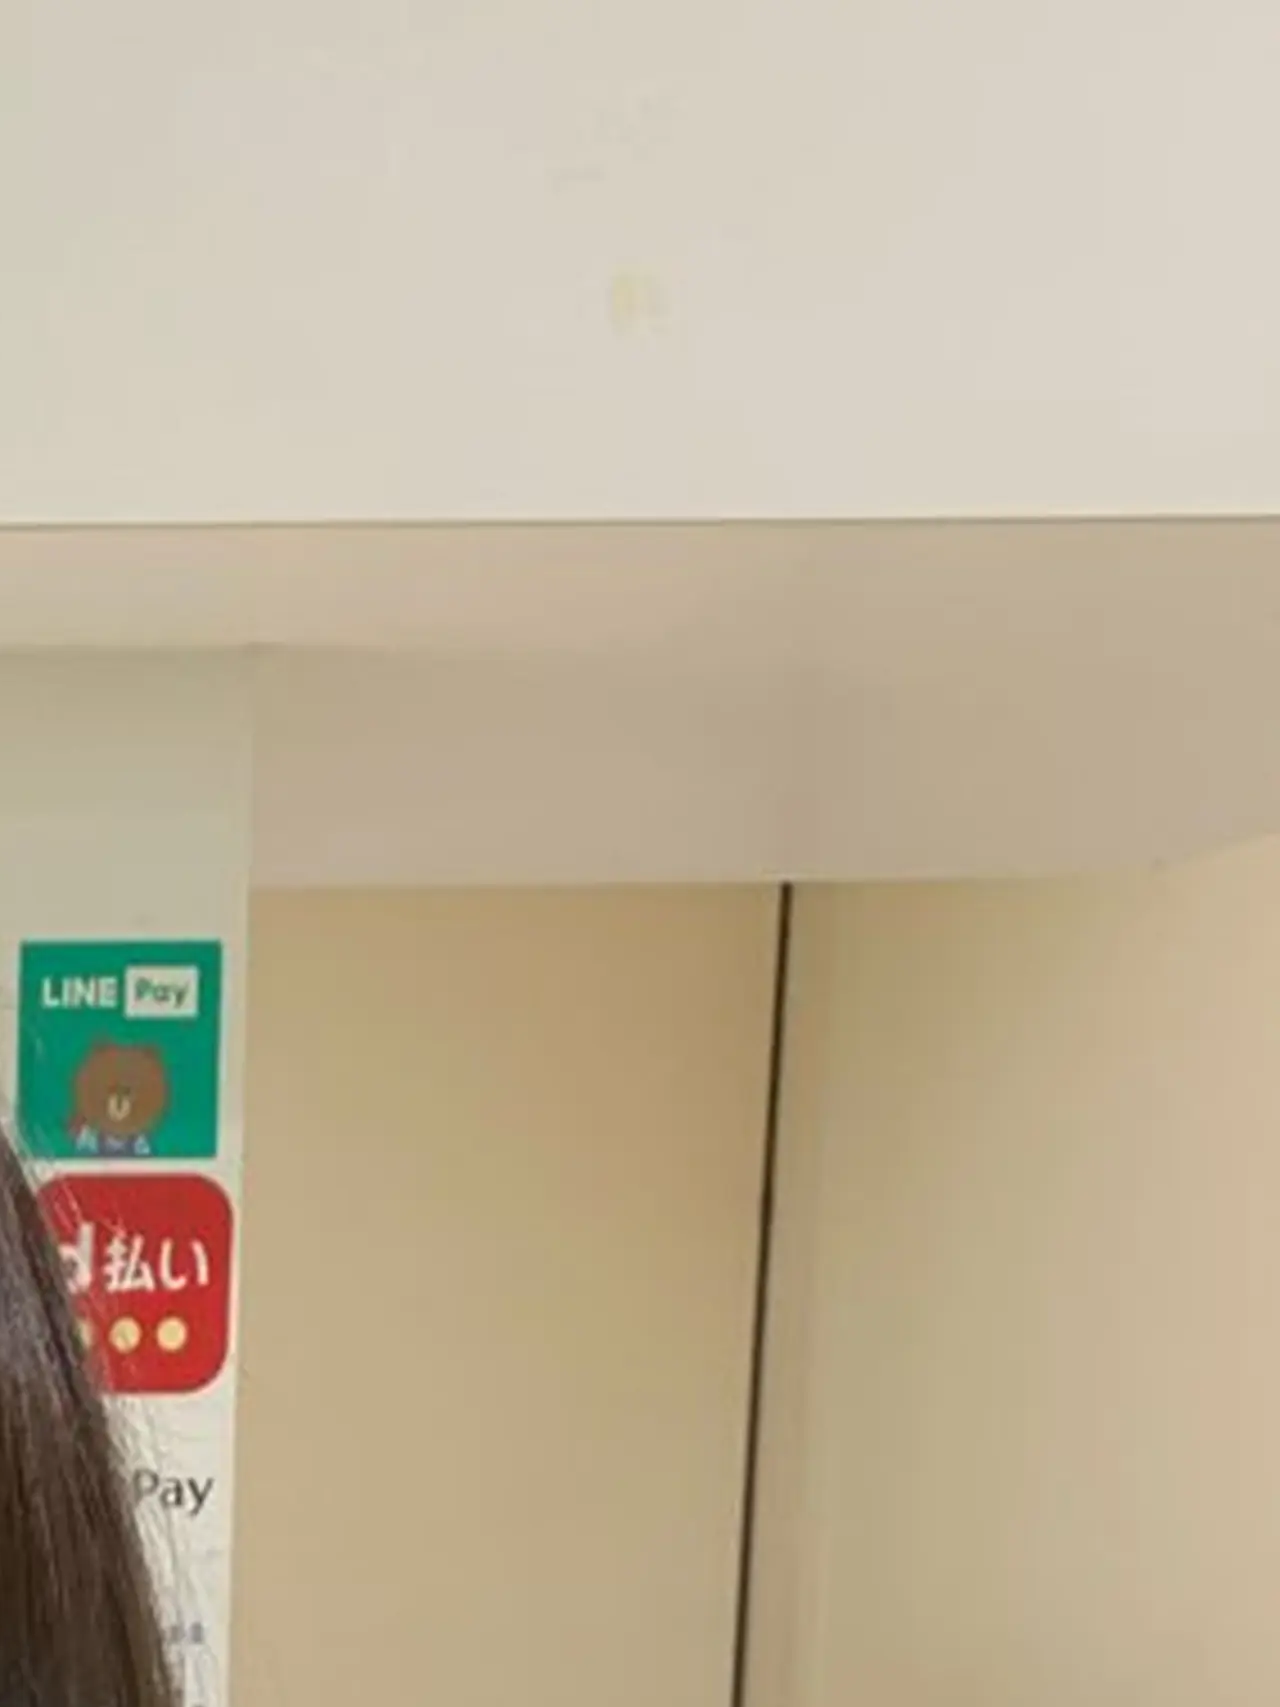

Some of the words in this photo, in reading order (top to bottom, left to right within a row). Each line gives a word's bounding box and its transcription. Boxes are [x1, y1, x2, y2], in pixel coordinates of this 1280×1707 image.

[43, 976, 117, 1009] LINE
[134, 975, 190, 1010] Pay
[57, 1221, 209, 1294] d払い
